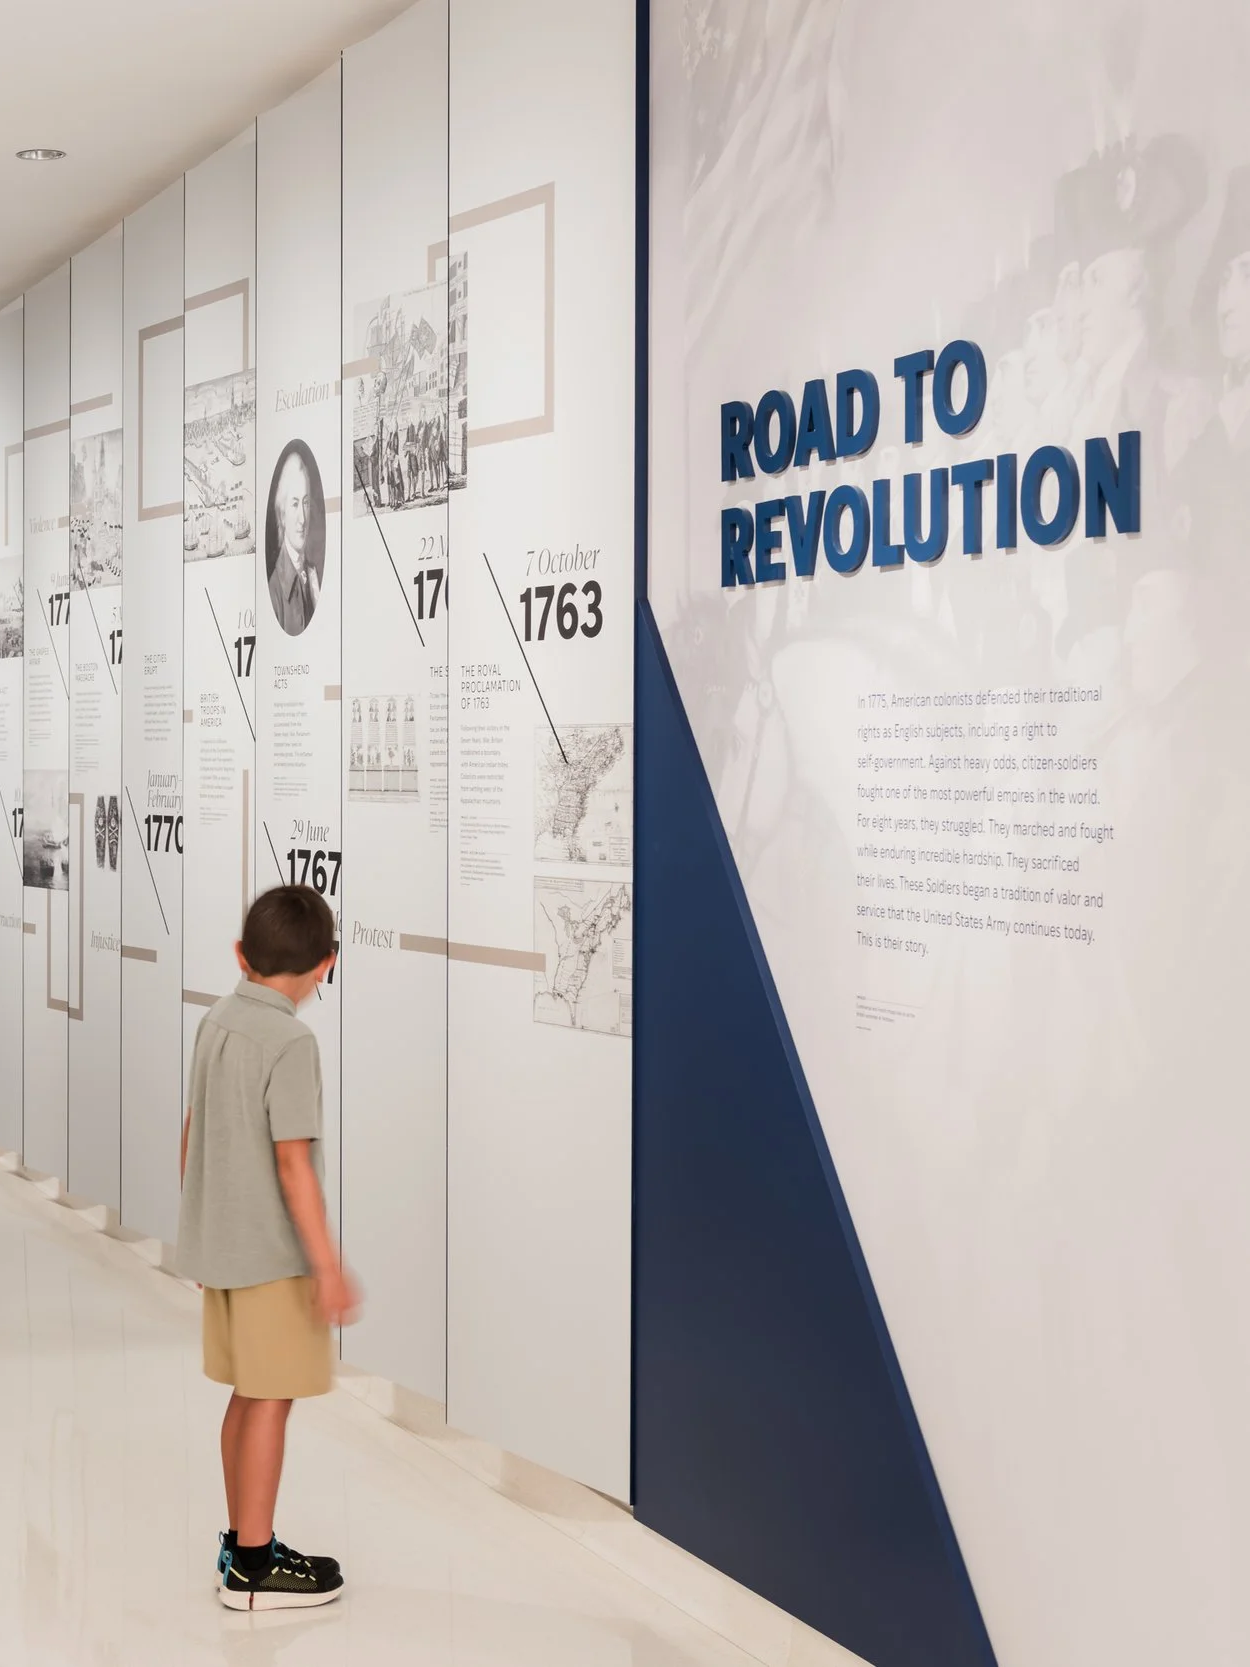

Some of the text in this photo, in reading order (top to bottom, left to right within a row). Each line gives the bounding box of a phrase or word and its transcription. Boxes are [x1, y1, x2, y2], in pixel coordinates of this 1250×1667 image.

[721, 339, 987, 482] ROAD TO
[721, 431, 1141, 587] REVOLUTION
[418, 536, 434, 560] 22
[526, 544, 600, 576] 7 October
[414, 568, 448, 620] 17
[520, 580, 603, 642] 1763
[234, 636, 256, 677] 17
[274, 664, 310, 676] TOWNSHEND
[274, 679, 288, 690] ACTS
[430, 666, 443, 678] THE
[461, 664, 501, 678] THE ROYAL
[461, 680, 521, 693] PROCLAMATION
[857, 685, 1102, 710] In 1775, American colonists defended their traditional
[461, 697, 490, 710] OF 1763
[858, 722, 1058, 742] rights as English subjects, including a right to
[857, 754, 1098, 773] self-government. Against heavy odds, citizen-soldiers
[857, 784, 1100, 806] fought one of the most powerful empires in the world.
[144, 814, 183, 854] 1770
[290, 820, 330, 844] 29 June
[857, 813, 1114, 844] For eight years, they struggled. They marched and fought
[857, 844, 1080, 872] while enduring incredible hardship. They sacrificed
[287, 849, 342, 896] 1767
[857, 874, 1104, 908] their lives. These Soldiers began a tradition of valor and
[352, 920, 394, 948] Protest
[856, 904, 1096, 946] service that the United States Army continues today.
[90, 930, 121, 952] Injustice
[857, 930, 928, 958] This is their story.
